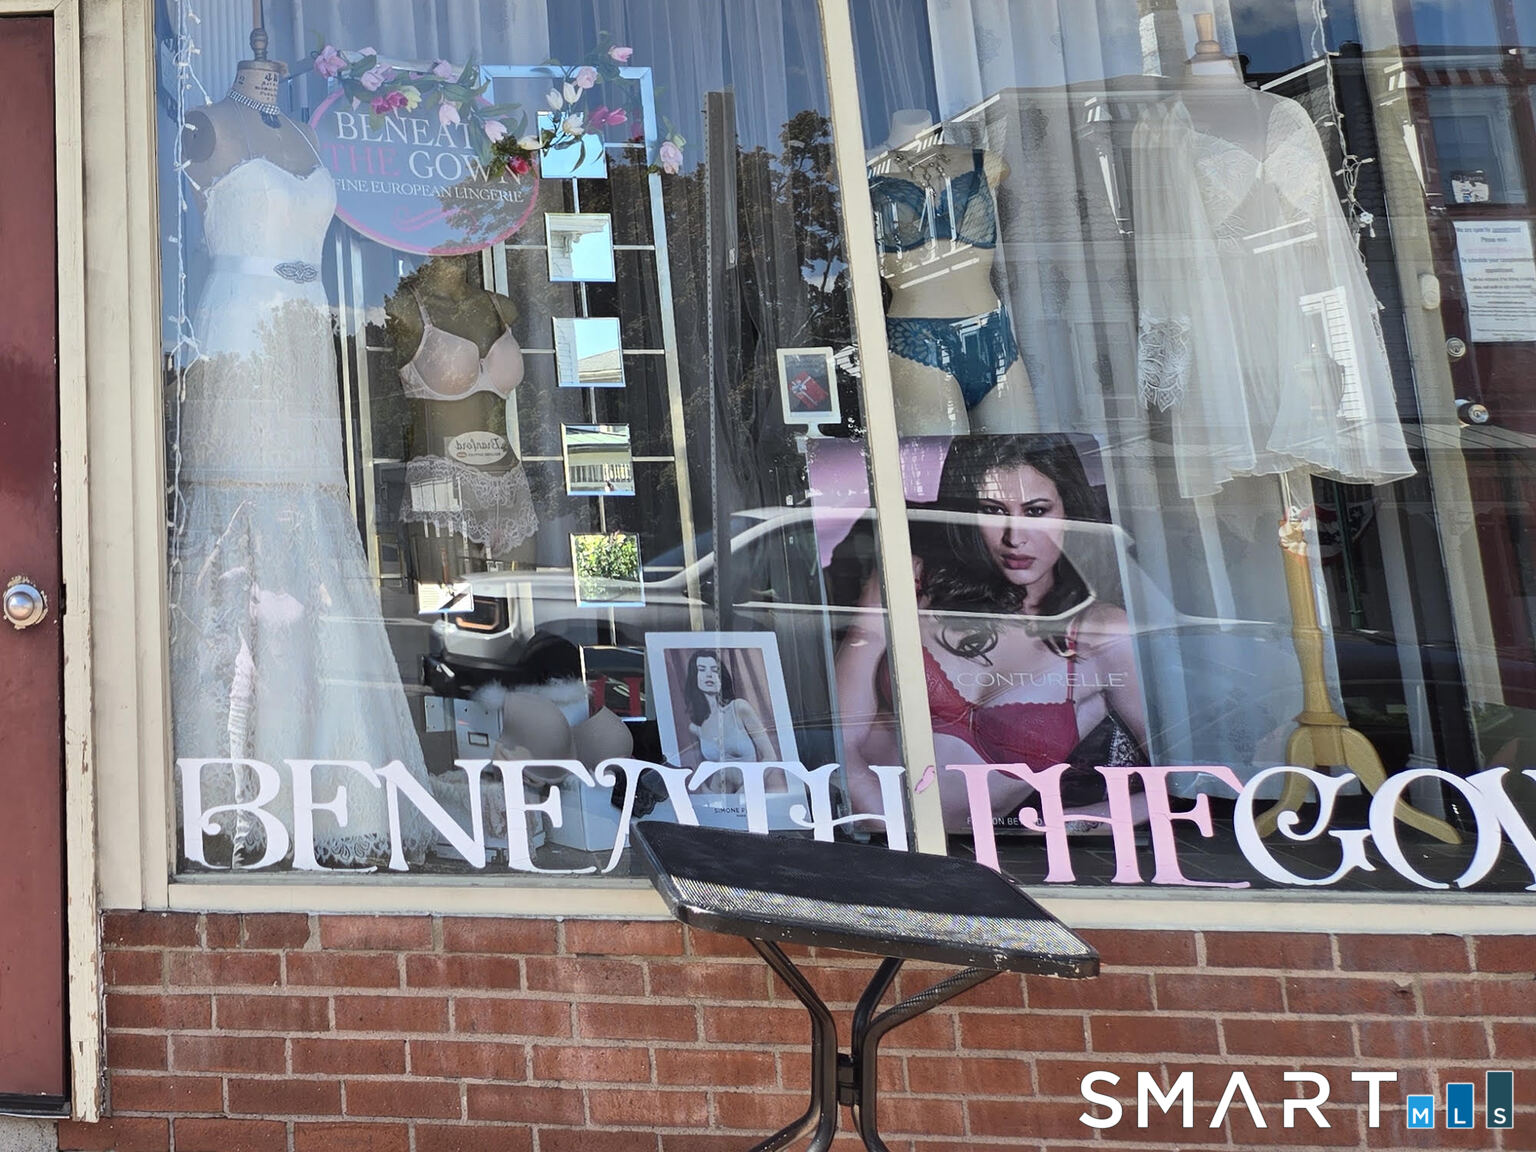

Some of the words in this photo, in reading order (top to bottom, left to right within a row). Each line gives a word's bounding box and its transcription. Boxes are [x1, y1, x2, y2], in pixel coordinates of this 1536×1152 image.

[334, 111, 476, 150] BENEAT
[323, 143, 400, 177] THE
[334, 179, 367, 193] FINE
[371, 181, 451, 199] EUROPEAN
[455, 186, 524, 203] LINGERIE
[957, 672, 1126, 687] CONTURELLE
[176, 757, 906, 874] BENEATH
[946, 762, 1251, 889] THE
